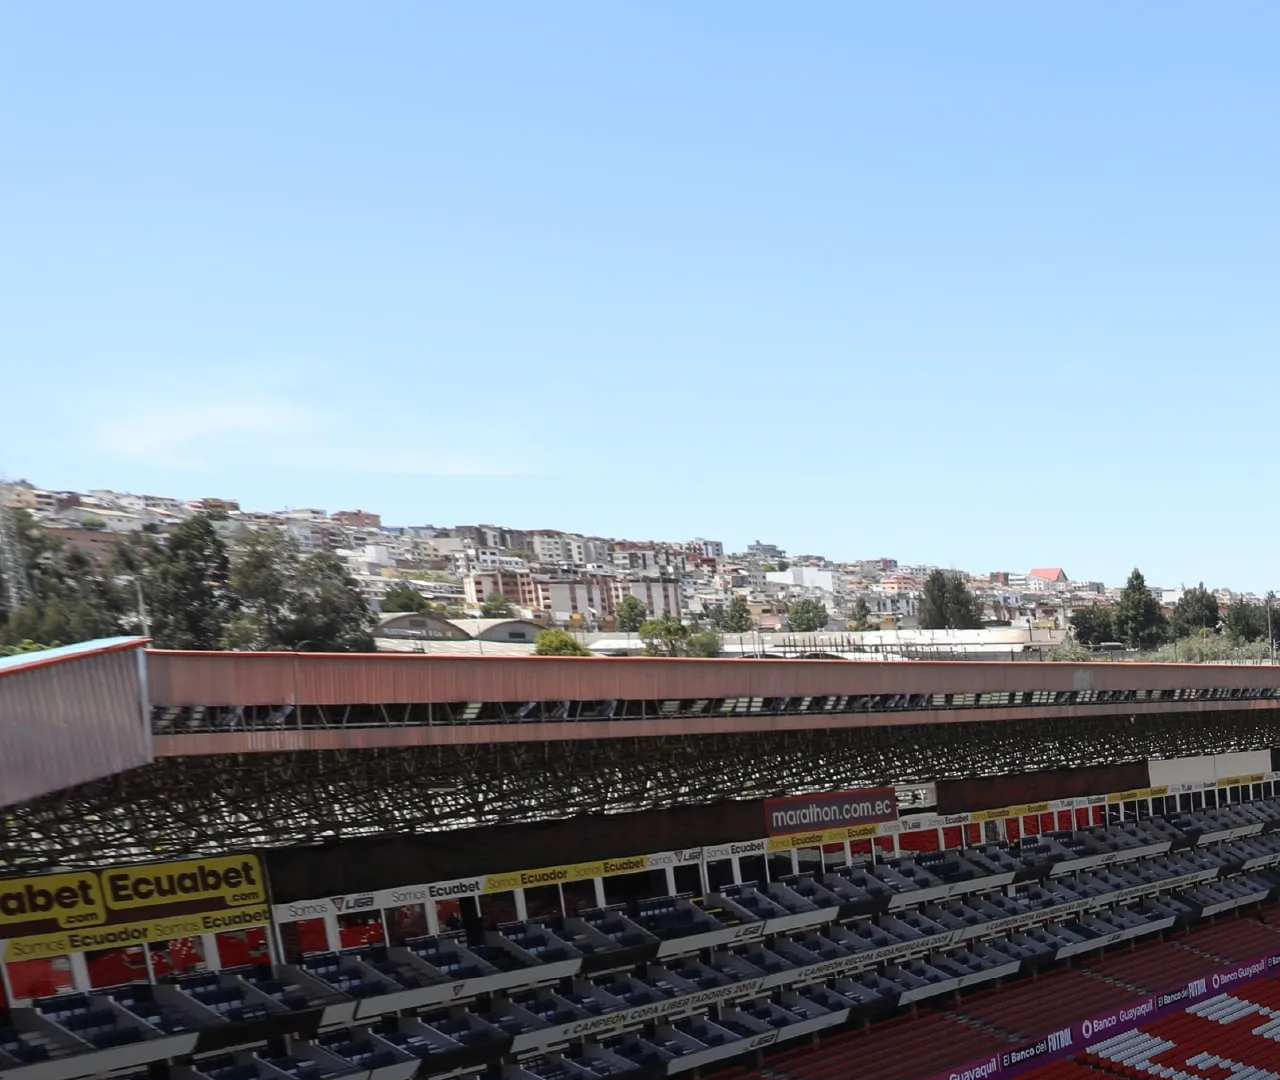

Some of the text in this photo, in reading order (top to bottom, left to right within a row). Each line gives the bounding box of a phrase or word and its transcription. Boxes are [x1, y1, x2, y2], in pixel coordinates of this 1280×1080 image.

[771, 798, 892, 828] marathon.com.ec
[944, 813, 969, 825] Ecuabet
[790, 825, 876, 846] Ecuador Ecuabet
[730, 841, 765, 855] Ecuabet
[107, 861, 257, 903] Ecuabet
[520, 870, 568, 885] Ecuador
[603, 858, 645, 873] Ecuabet
[391, 880, 481, 903] Somos Ecuabet
[65, 911, 98, 925] .com
[288, 902, 328, 918] Somos
[12, 908, 270, 956] Somos Ecuador Somos Ecuabet
[1220, 958, 1266, 985] Banco Guayaquil
[1164, 990, 1182, 1005] Banco
[573, 1012, 628, 1035] CAMPEÓN
[630, 1006, 659, 1020] COPA
[660, 986, 732, 1014] LIBERTADORES
[1093, 998, 1154, 1033] Banco Guayaquil
[750, 1034, 777, 1049] LIGA
[1003, 1054, 1011, 1067] El
[1011, 1047, 1036, 1064] Banco
[1035, 1041, 1048, 1054] del
